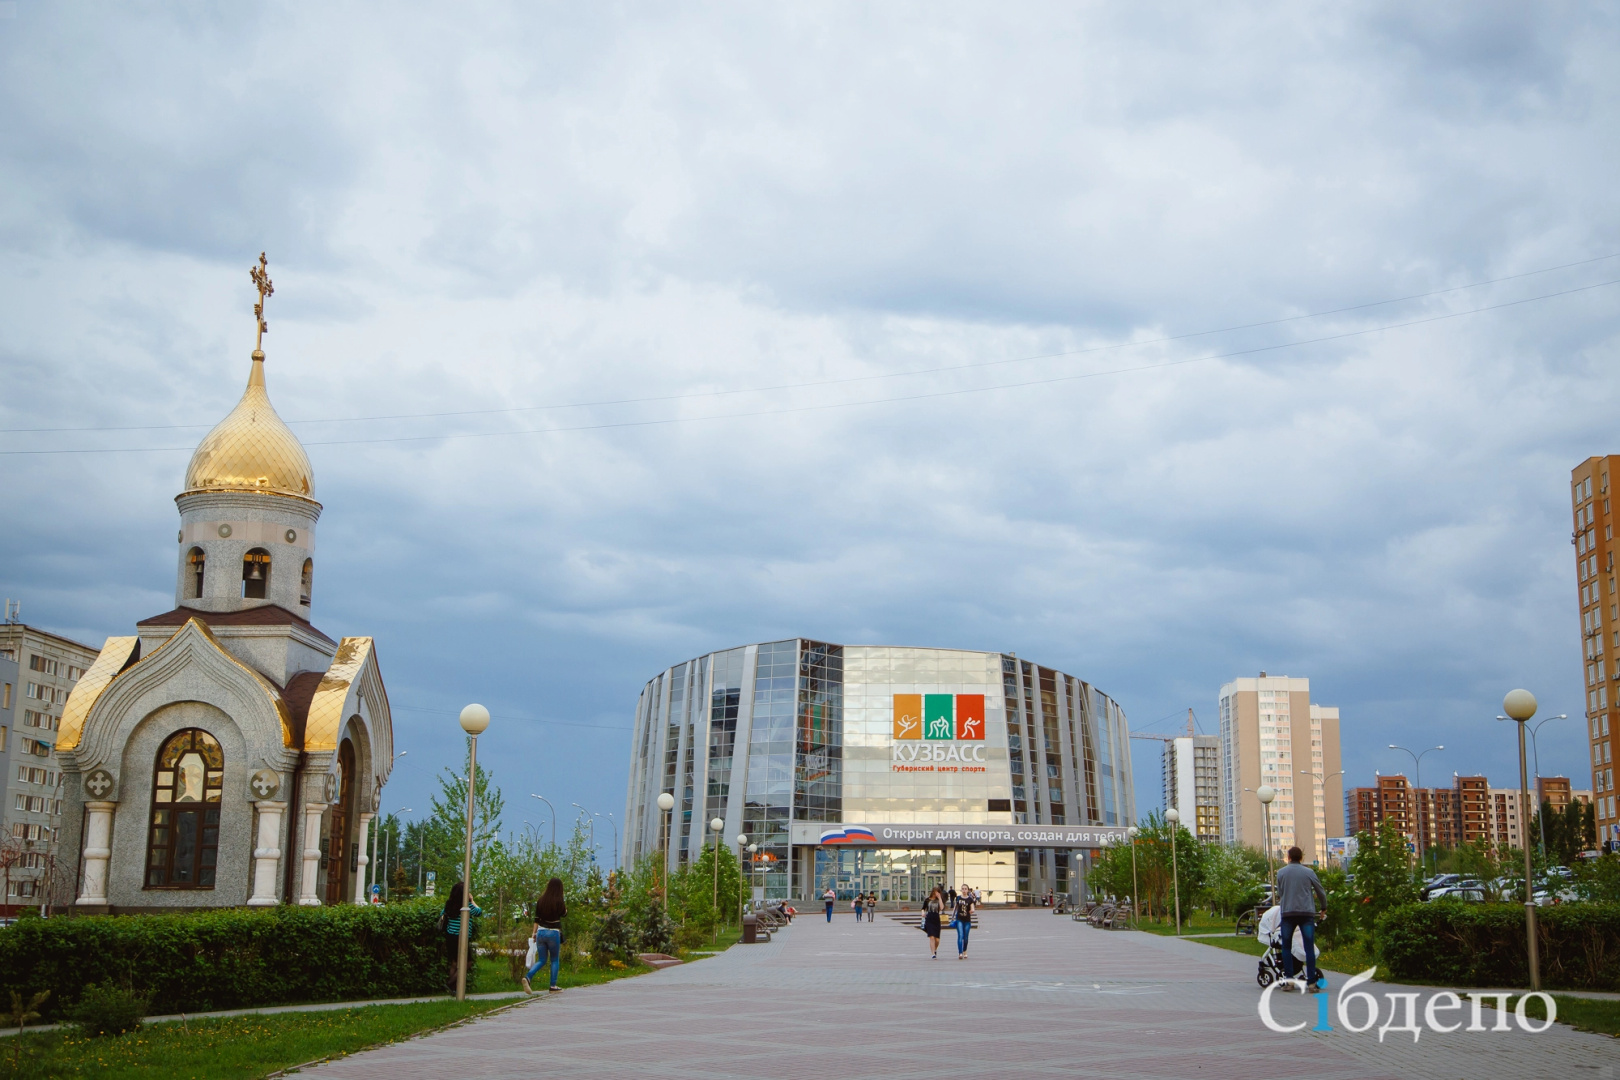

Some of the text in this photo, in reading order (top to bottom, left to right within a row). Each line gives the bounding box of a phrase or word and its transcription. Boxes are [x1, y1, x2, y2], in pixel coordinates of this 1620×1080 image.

[893, 744, 985, 762] КУЗБАСС
[892, 765, 934, 773] Губернский
[883, 828, 933, 841] Открыт
[935, 830, 961, 841] для
[965, 831, 1014, 842] спорта,
[1017, 831, 1063, 842] создан
[1066, 832, 1090, 843] для
